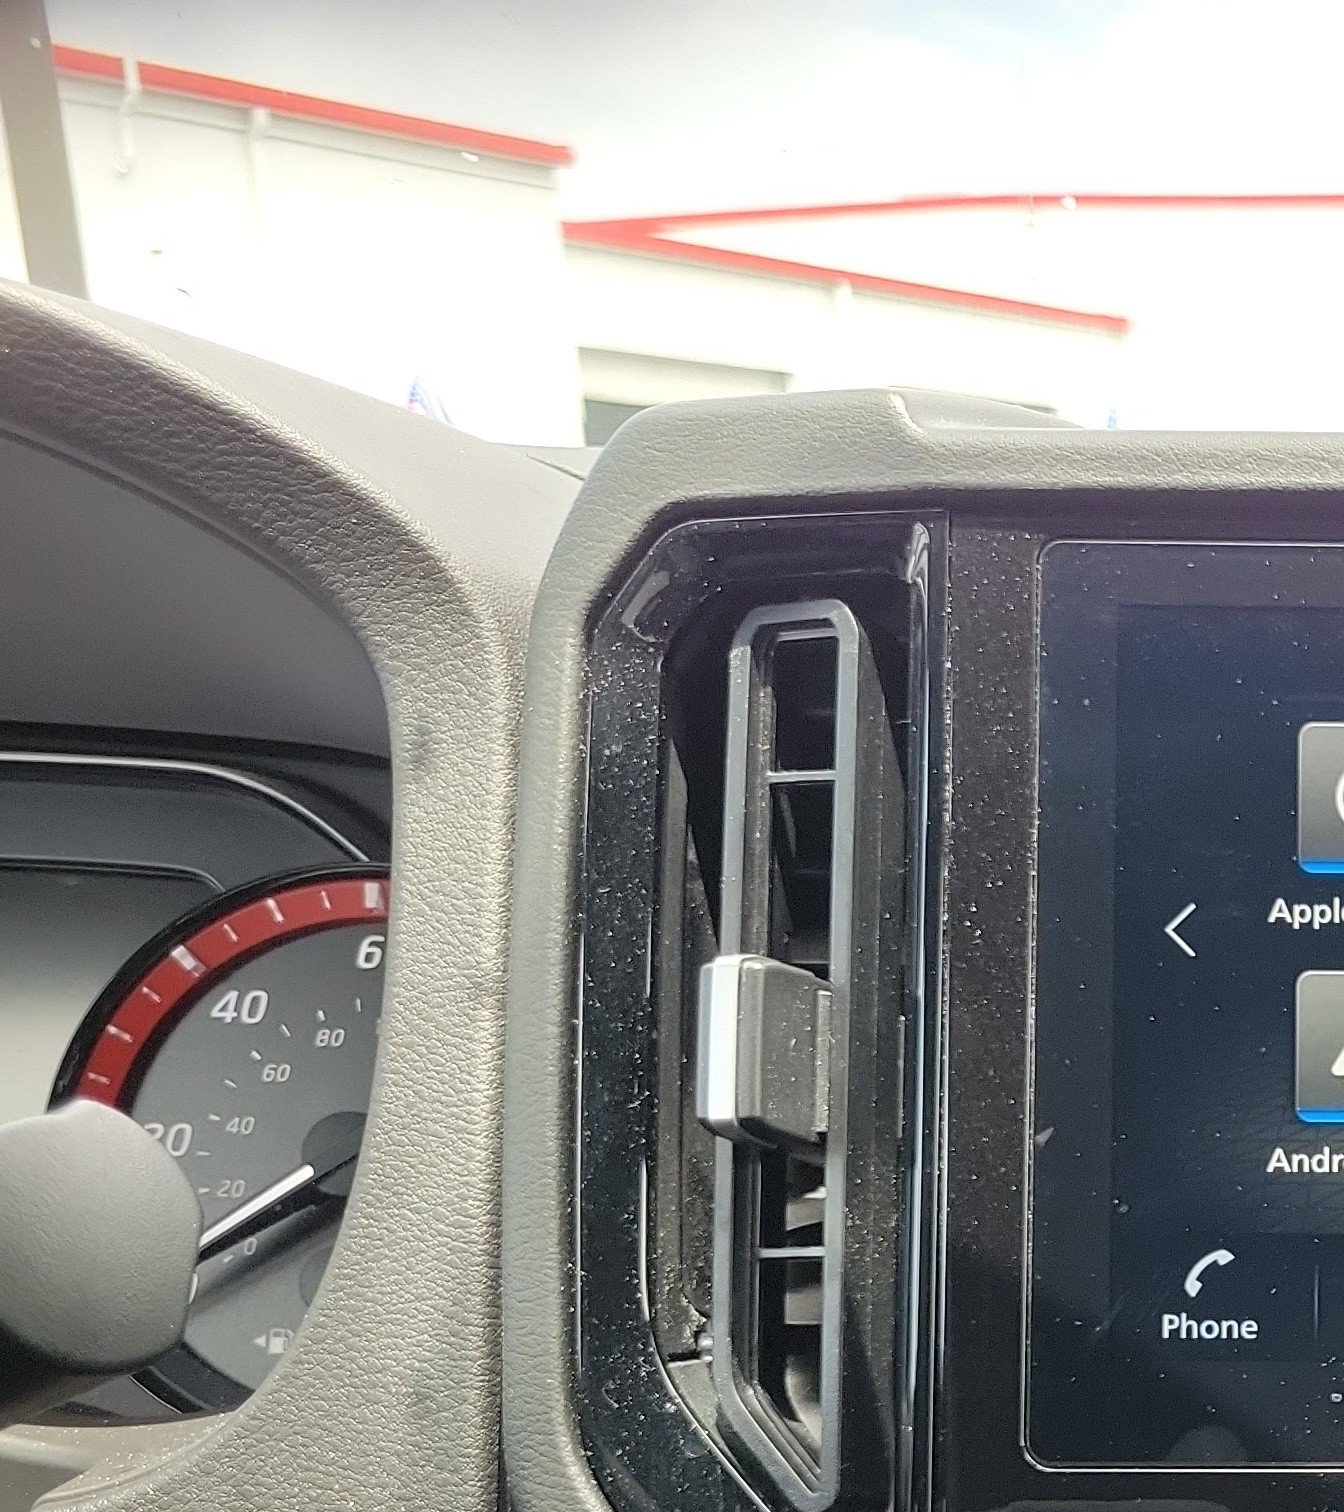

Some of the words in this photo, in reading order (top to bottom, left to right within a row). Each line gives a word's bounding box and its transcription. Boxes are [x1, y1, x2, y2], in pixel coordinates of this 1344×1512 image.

[210, 990, 269, 1024] 40
[315, 1028, 346, 1047] 80
[261, 1064, 292, 1082] 60
[225, 1116, 256, 1135] 40
[216, 1180, 246, 1198] 20
[244, 1237, 258, 1256] 0
[1161, 1313, 1259, 1340] Phone
